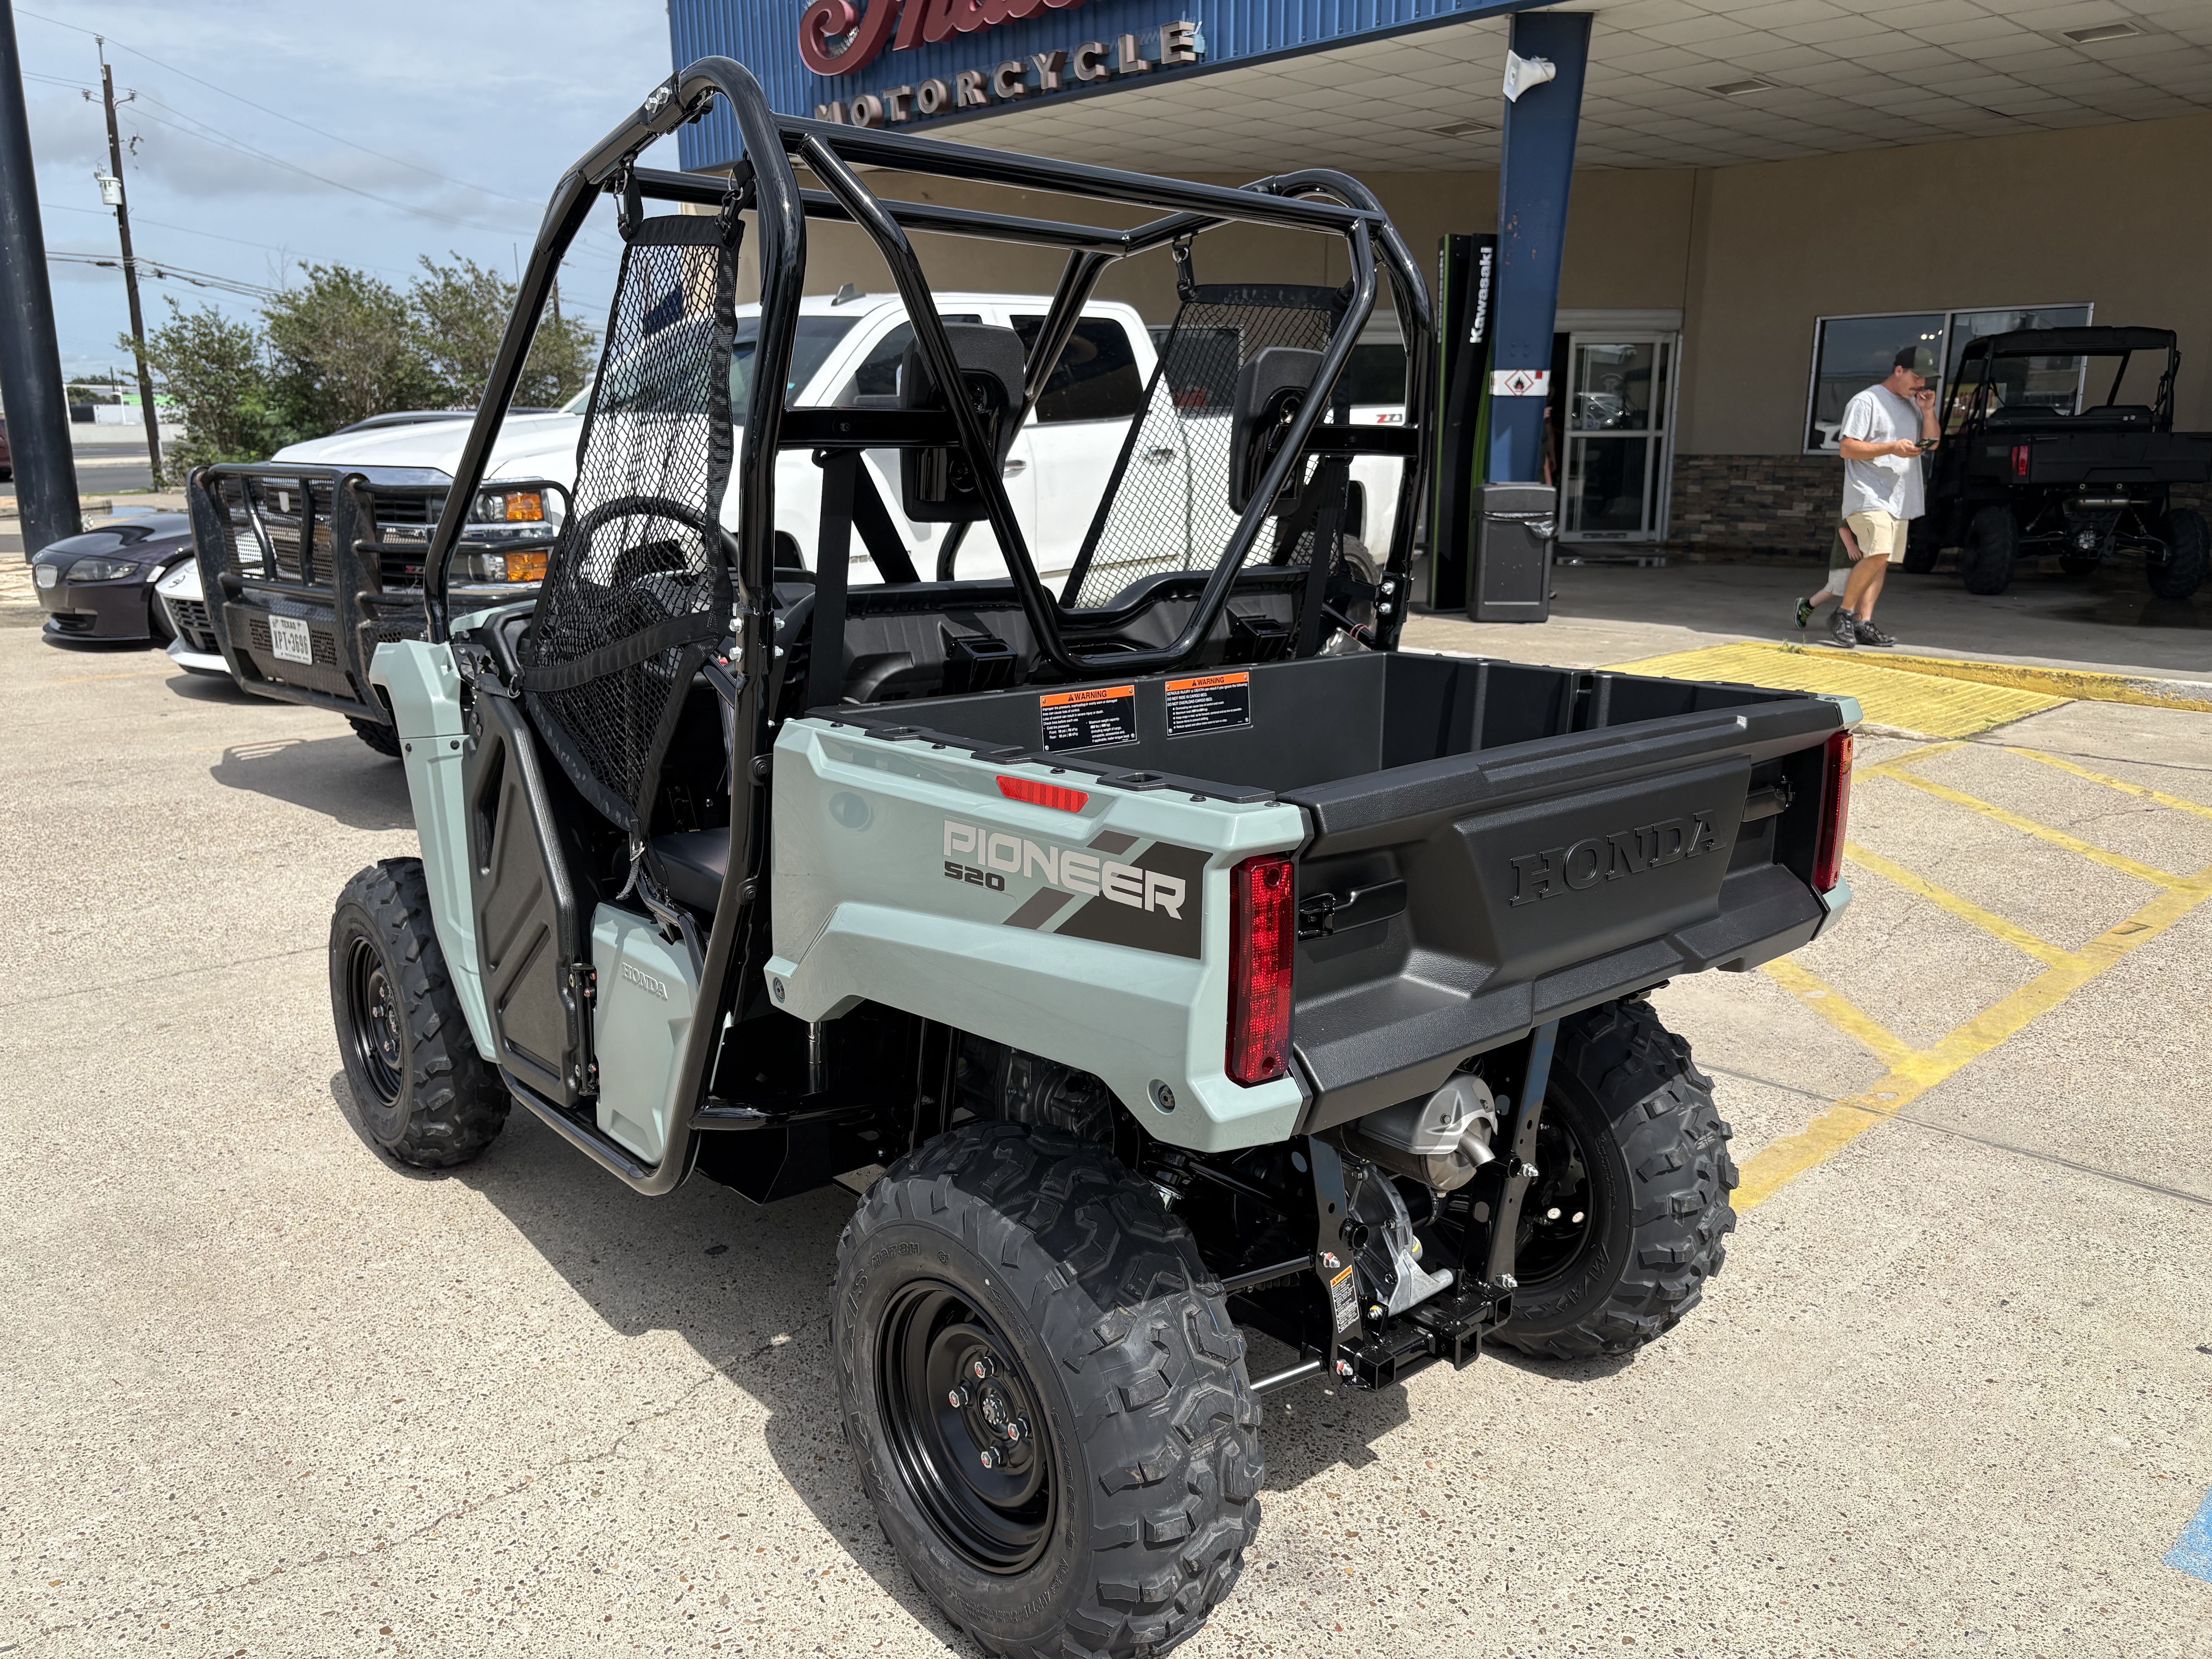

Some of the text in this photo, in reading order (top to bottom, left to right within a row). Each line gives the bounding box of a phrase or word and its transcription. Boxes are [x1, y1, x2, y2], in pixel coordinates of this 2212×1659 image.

[814, 21, 1197, 129] MOTORCYCLE
[1470, 247, 1493, 343] Kawasaki
[1376, 414, 1402, 424] Z71
[281, 620, 296, 630] TEXAS
[1074, 690, 1107, 701] WARNING
[1197, 677, 1224, 686] WARNING
[943, 819, 1186, 921] PIONEER
[944, 860, 1005, 891] 520
[1509, 809, 1727, 907] HONDA
[621, 962, 668, 1000] HONDA
[842, 1268, 891, 1503] MAXXIS
